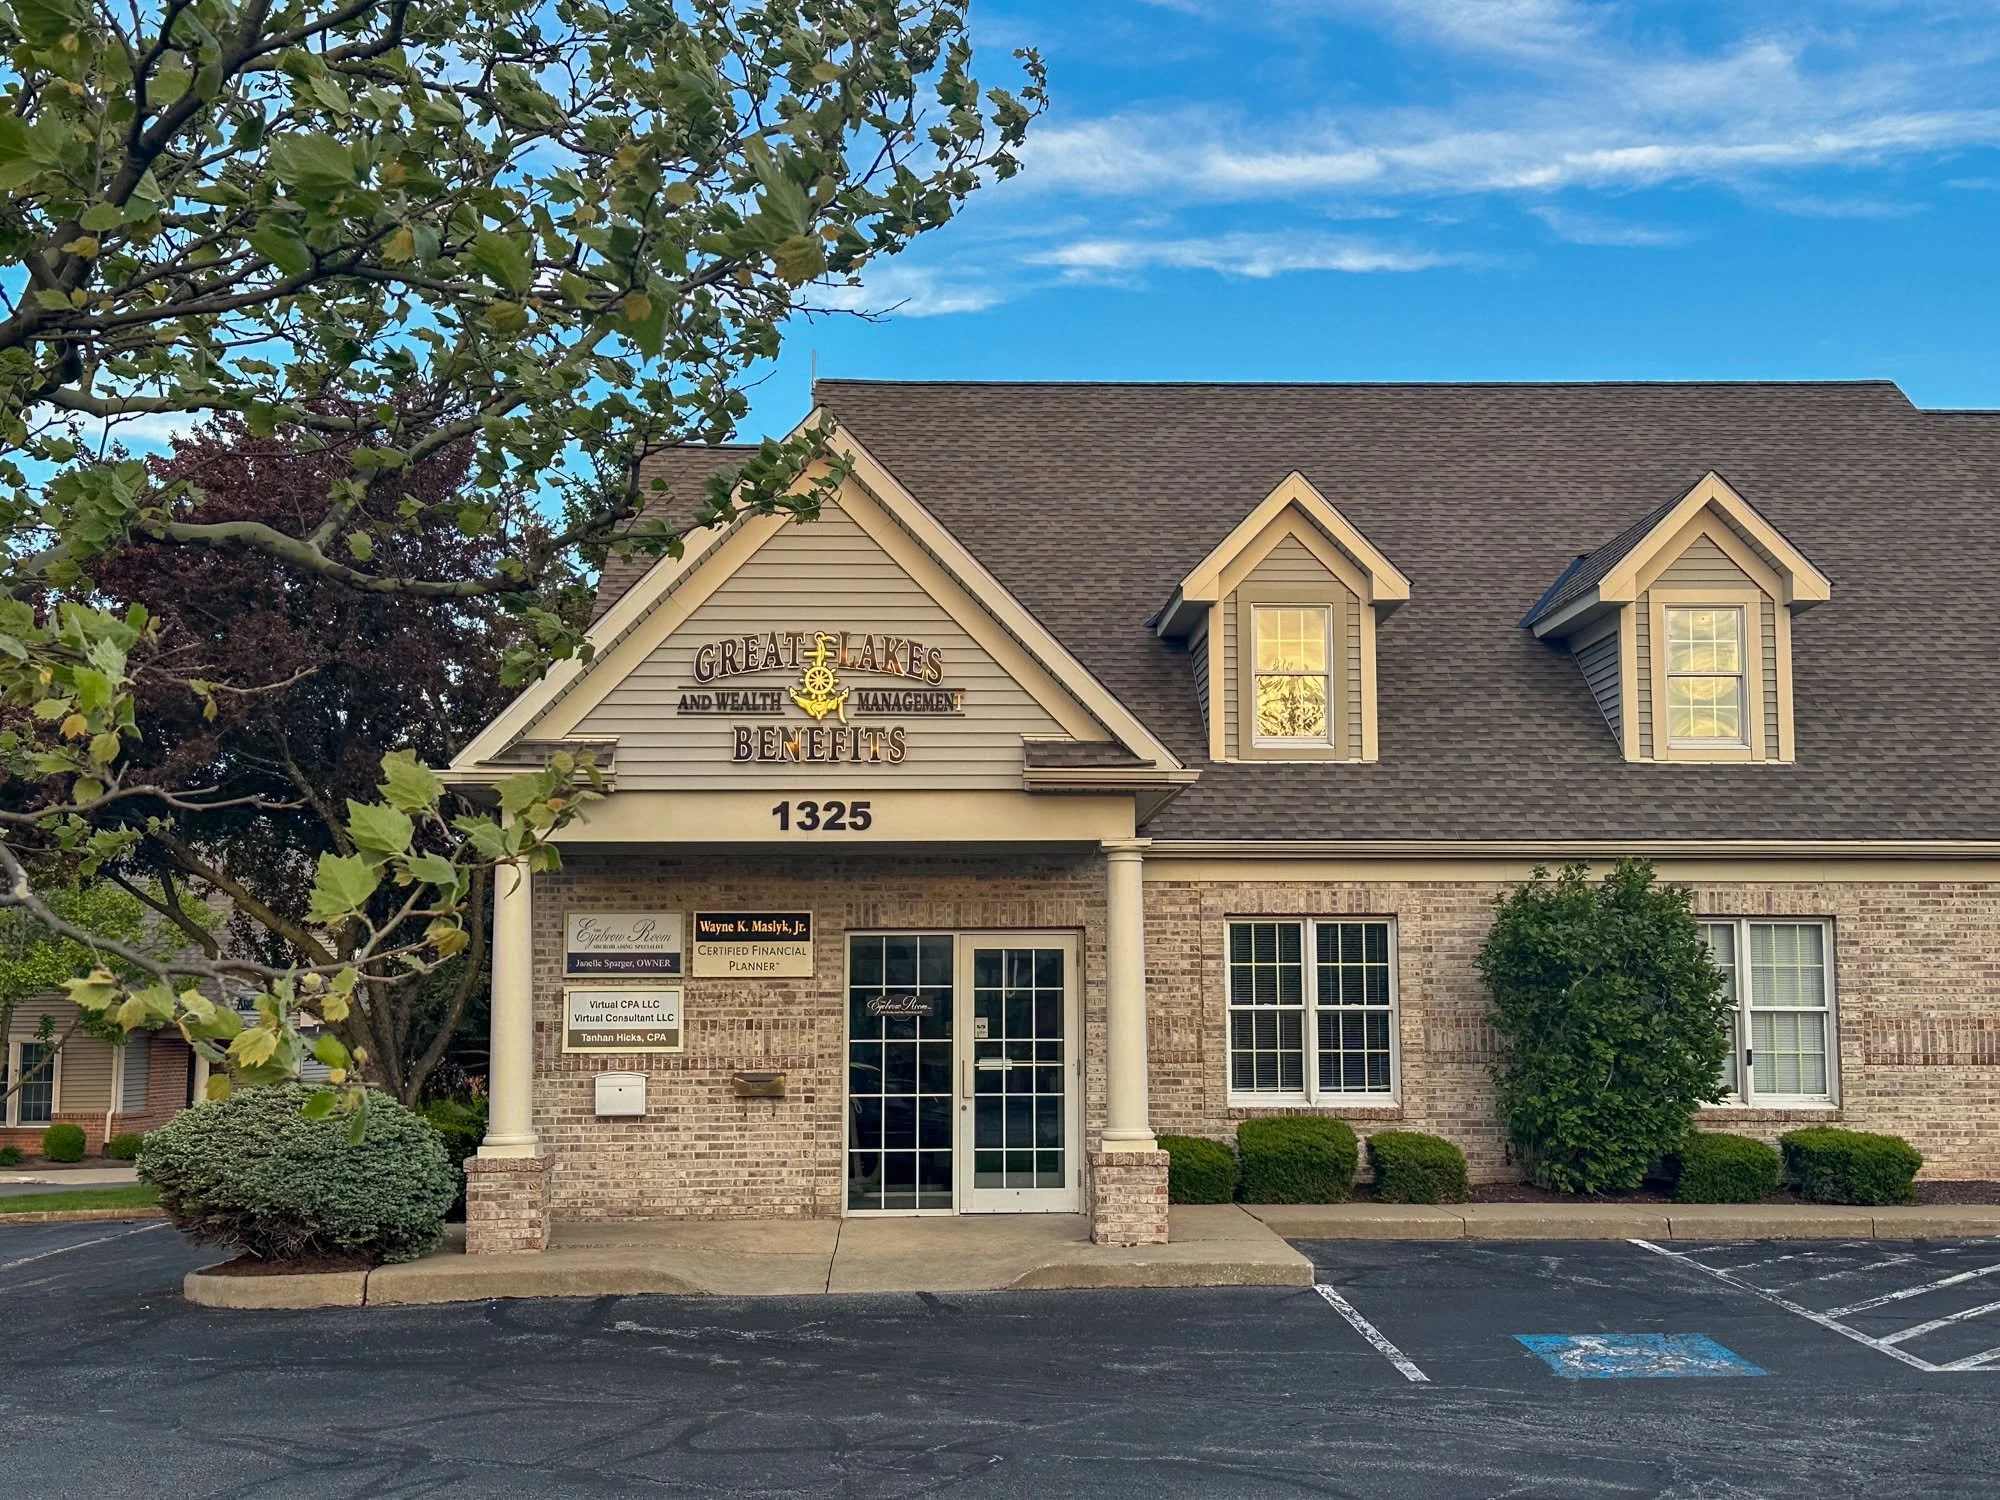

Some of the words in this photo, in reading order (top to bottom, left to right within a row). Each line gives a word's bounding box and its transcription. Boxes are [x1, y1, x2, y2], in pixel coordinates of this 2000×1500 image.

[693, 631, 806, 683] GREAT
[837, 630, 944, 686] LAKES
[677, 694, 712, 711] AND
[714, 691, 782, 712] WEALTH
[856, 691, 964, 713] MANAGEMENT
[731, 725, 907, 764] BENEFITS
[772, 801, 872, 831] 1325
[576, 917, 625, 951] Eyebrow
[627, 918, 672, 942] Room
[700, 920, 734, 936] Wayne
[737, 920, 749, 933] K.
[751, 919, 792, 936] Maslyk,
[793, 920, 807, 936] Jr.
[697, 944, 749, 956] CERTIFIED
[752, 945, 807, 956] FINANCIAL
[575, 958, 602, 968] Janelle
[603, 959, 635, 969] Sparger,
[636, 959, 671, 968] OWNER
[589, 1000, 618, 1009] Virtual
[620, 1000, 640, 1009] CPA
[642, 1000, 660, 1009] LLC
[574, 1014, 603, 1022] Virtual
[605, 1013, 654, 1022] Consultant
[656, 1013, 674, 1022] LLC
[581, 1033, 614, 1042] Tanhan
[616, 1033, 645, 1043] Hicks,
[646, 1033, 667, 1042] CPA
